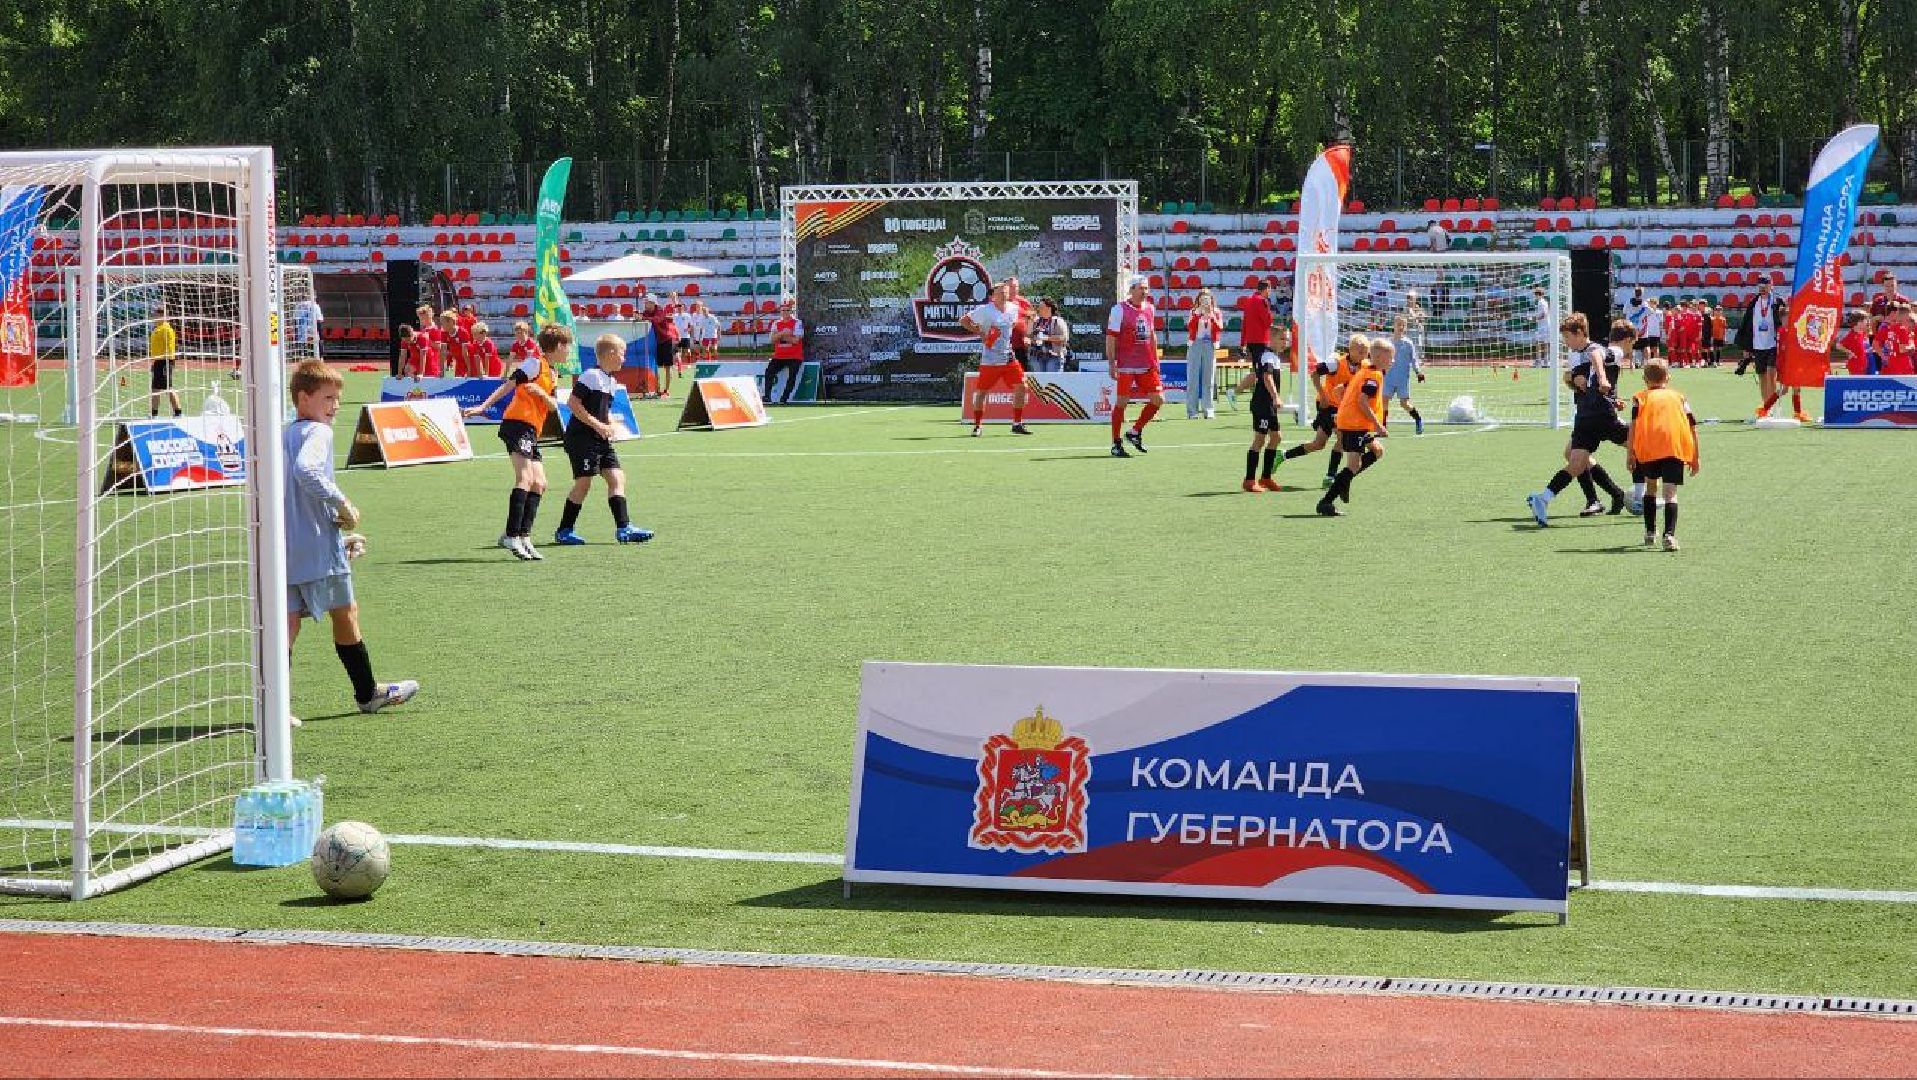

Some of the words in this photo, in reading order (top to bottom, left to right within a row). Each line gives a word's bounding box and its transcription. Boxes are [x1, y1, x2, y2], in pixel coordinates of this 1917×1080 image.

[1813, 204, 1833, 293] КОМАНДА
[923, 304, 955, 320] МАТЧ
[1842, 389, 1917, 402] МОСОБЛ
[1842, 401, 1903, 412] СПОРТ
[1131, 756, 1365, 800] КОМАНДА
[1126, 811, 1453, 854] ГУБЕРНАТОРА
